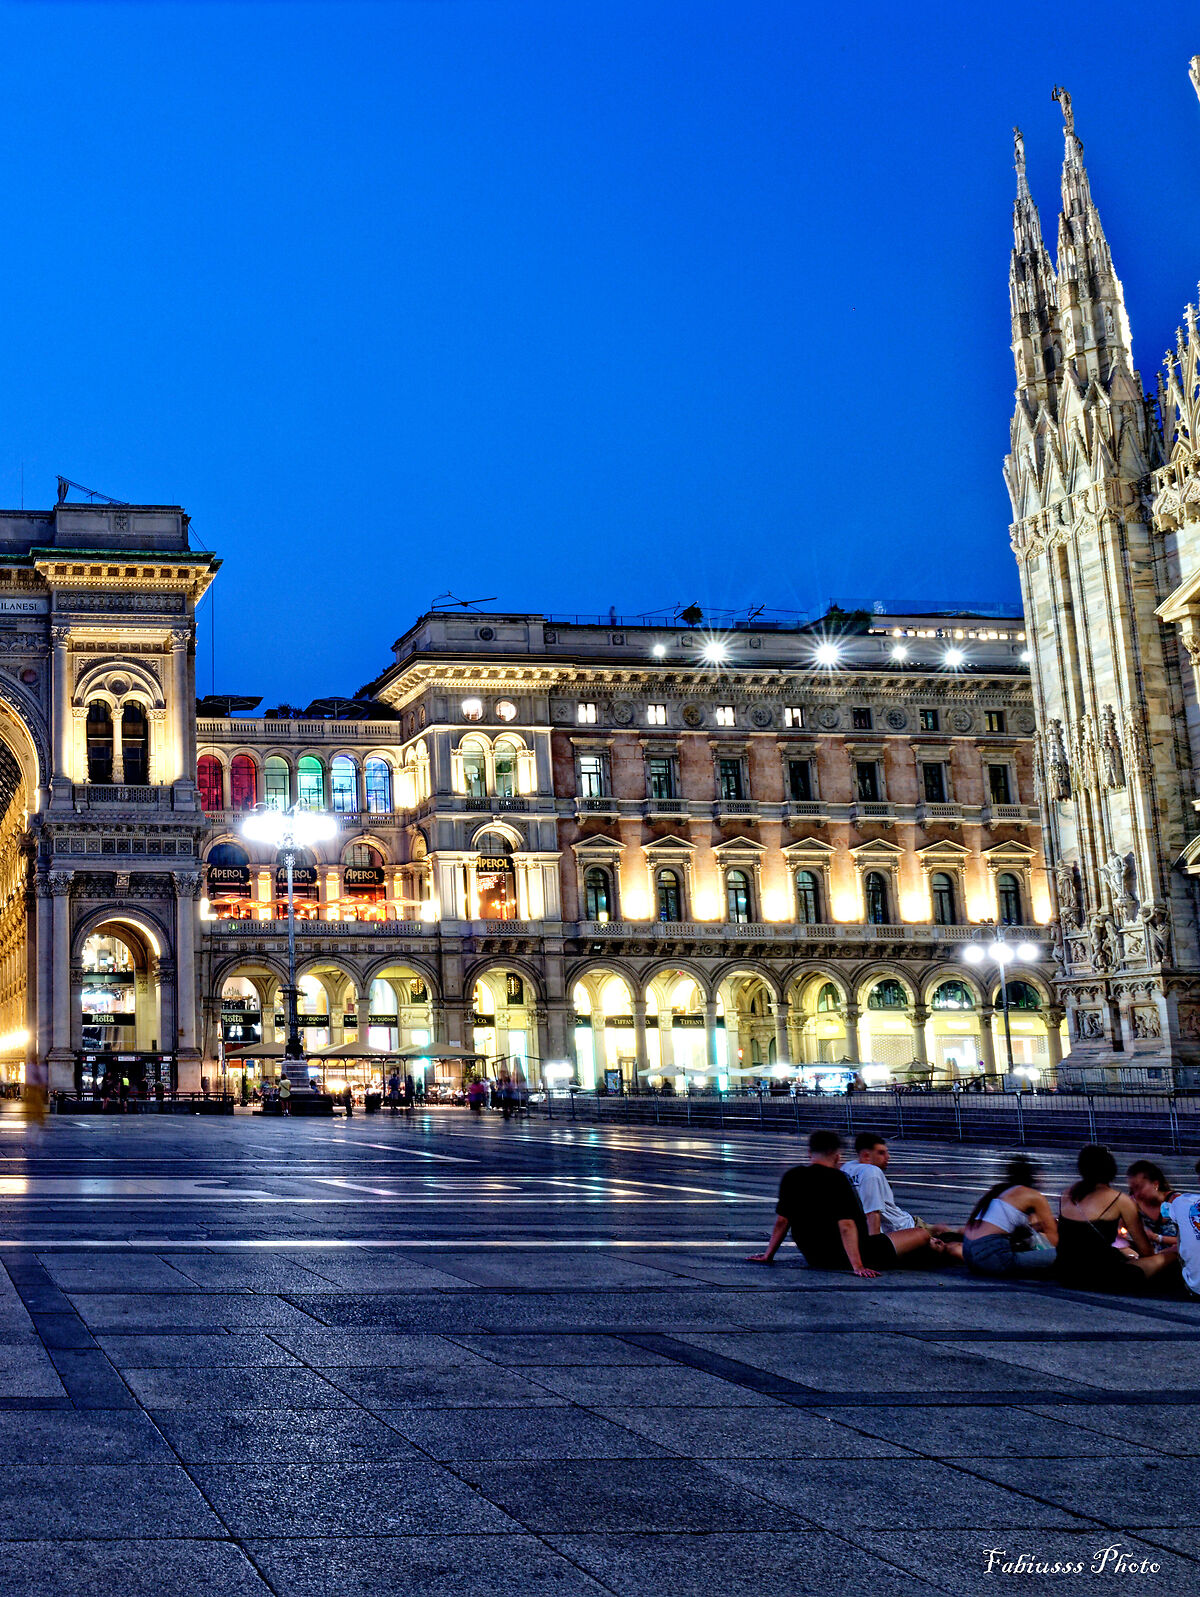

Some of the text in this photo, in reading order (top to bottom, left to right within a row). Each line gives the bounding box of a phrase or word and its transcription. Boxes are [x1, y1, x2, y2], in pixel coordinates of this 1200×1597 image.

[476, 856, 509, 868] APEROL
[210, 867, 244, 879] APEROL
[345, 868, 379, 880] APEROL
[91, 1013, 115, 1023] Motta
